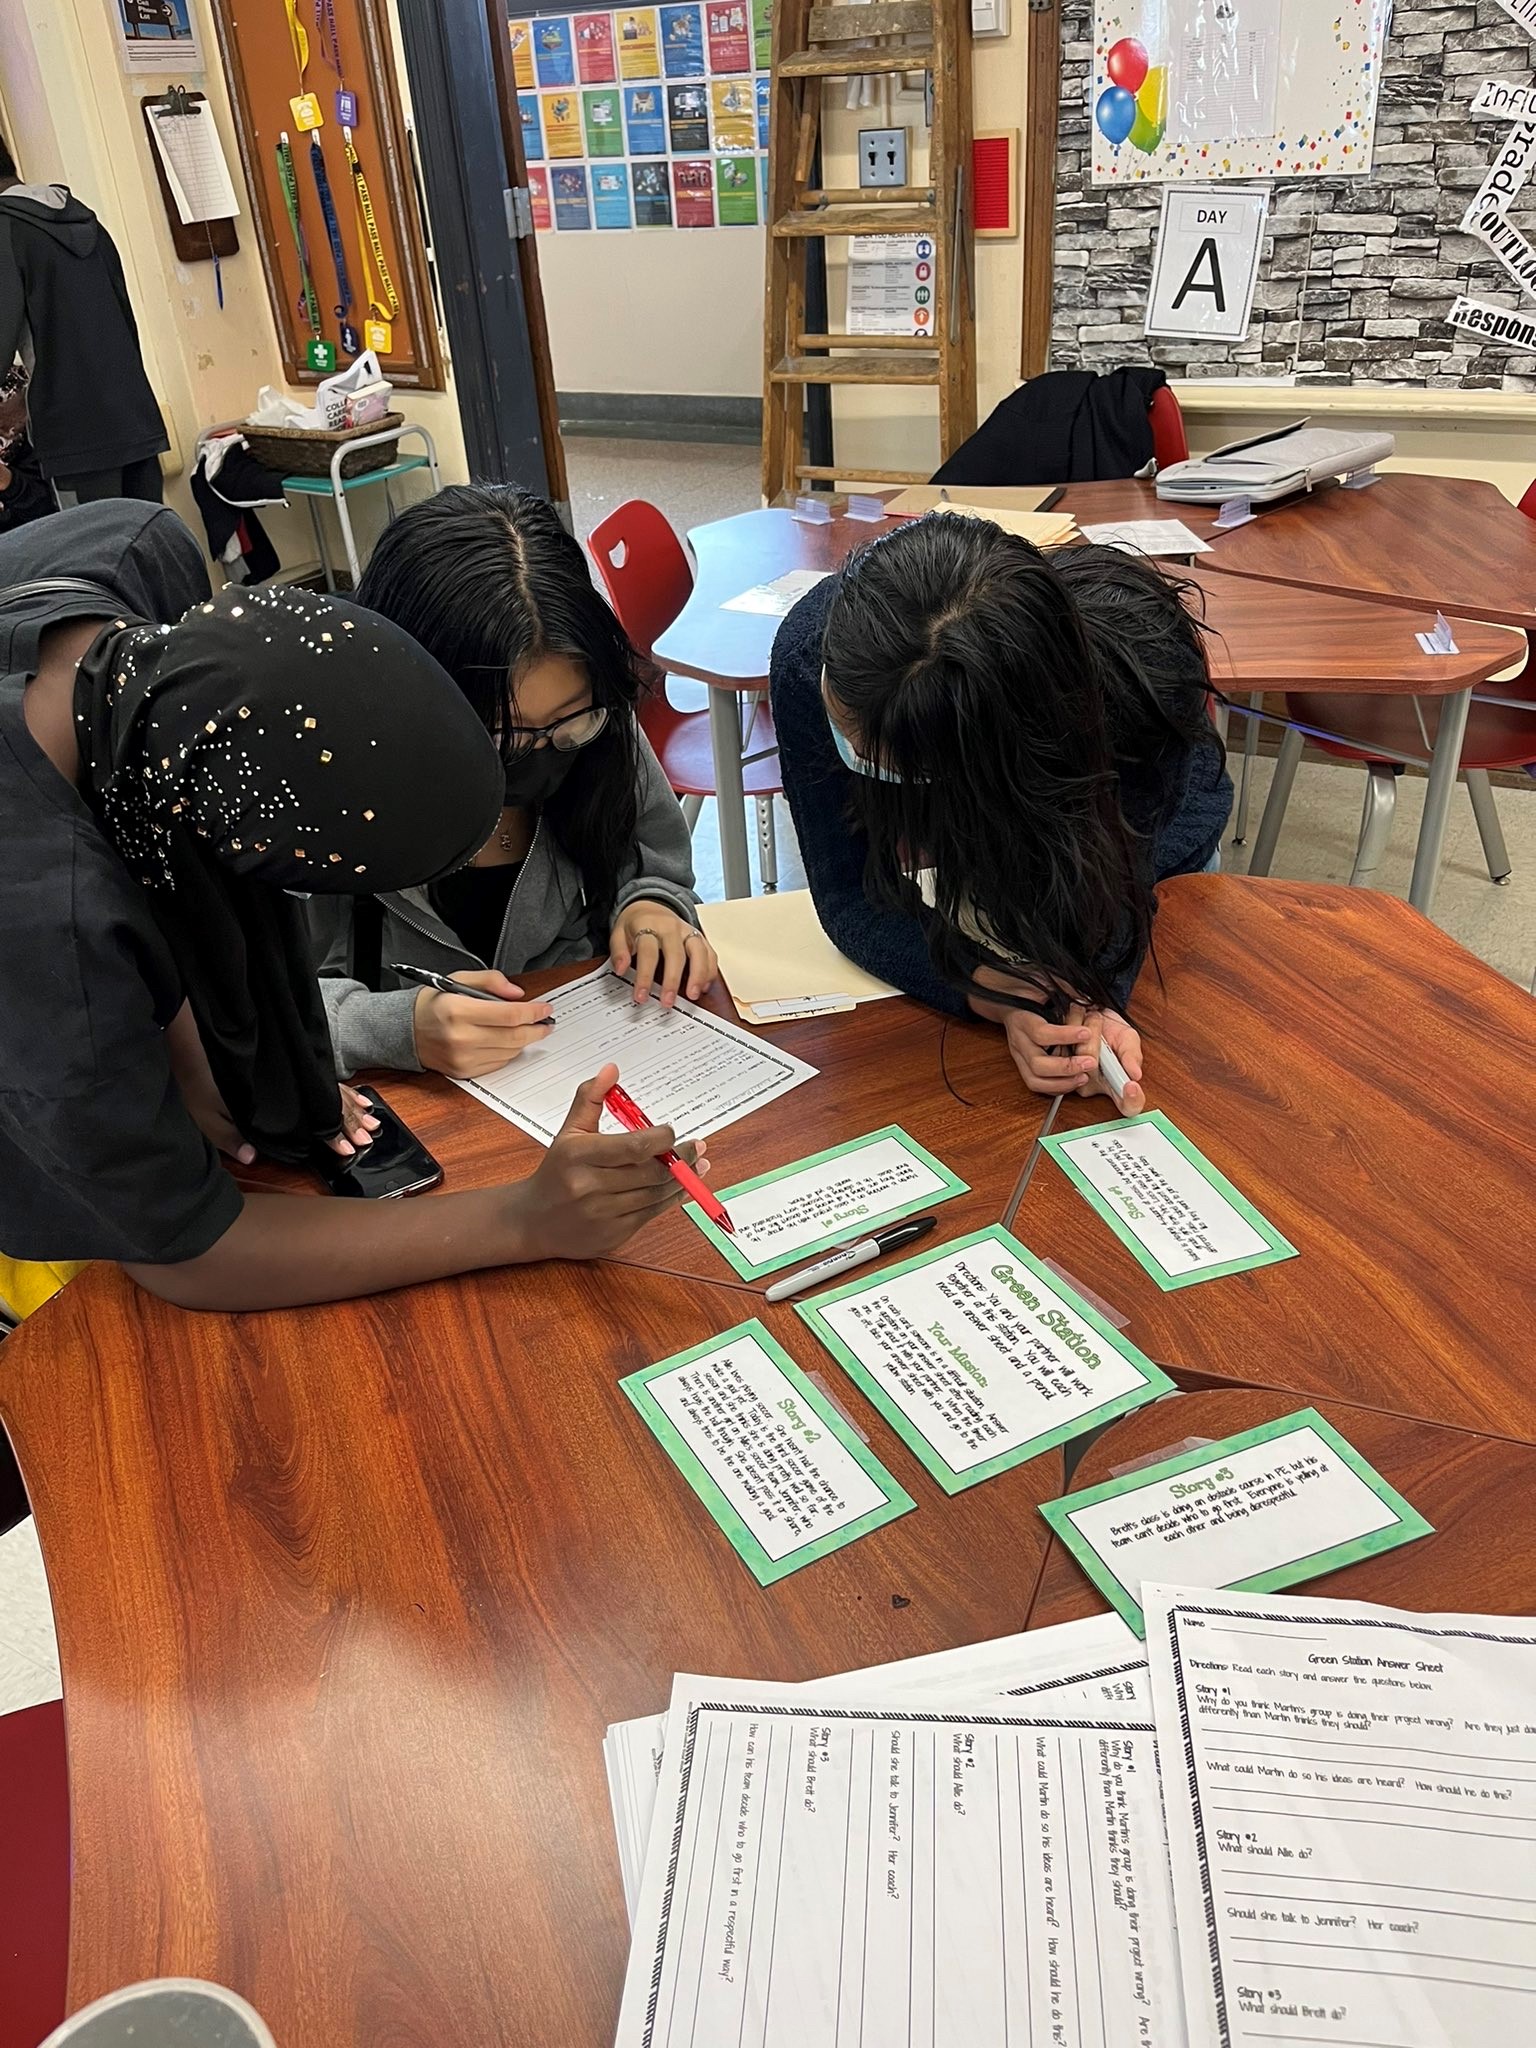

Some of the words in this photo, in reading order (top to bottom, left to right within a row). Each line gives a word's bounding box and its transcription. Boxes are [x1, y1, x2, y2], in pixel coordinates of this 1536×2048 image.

[364, 203, 373, 221] HALL
[1197, 209, 1228, 224] DAY
[368, 222, 378, 240] PASS
[373, 241, 382, 258] HALL
[378, 259, 388, 277] PASS
[1171, 237, 1226, 313] A
[936, 1281, 958, 1298] need
[963, 1310, 990, 1331] answer
[987, 1335, 1013, 1354] sheet
[1008, 1356, 1028, 1370] and
[991, 1265, 1041, 1312] Green
[1035, 1309, 1101, 1370] Station
[927, 1321, 952, 1347] Your
[986, 1292, 1002, 1307] You
[999, 1308, 1018, 1321] and
[1010, 1321, 1033, 1335] your
[1026, 1338, 1061, 1363] partner
[1058, 1365, 1075, 1377] will
[1070, 1377, 1093, 1397] work
[776, 1398, 807, 1430] Story
[1169, 1477, 1216, 1499] Story
[1183, 1618, 1205, 1627] Name
[1308, 1653, 1338, 1664] Green
[1342, 1655, 1373, 1666] Station
[1377, 1657, 1411, 1670] Answer
[1415, 1661, 1443, 1673] Sheet
[1195, 1684, 1217, 1697] Story
[749, 1723, 759, 1738] How
[747, 1741, 755, 1755] can
[745, 1758, 755, 1769] his
[743, 1772, 753, 1790] team
[739, 1793, 751, 1817] decide
[737, 1821, 748, 1837] who
[1216, 1829, 1240, 1844] Story
[736, 1841, 746, 1849] to
[1217, 1842, 1243, 1853] What
[1247, 1844, 1273, 1856] should
[1277, 1847, 1294, 1858] Allie
[1298, 1847, 1313, 1859] do?
[732, 1853, 742, 1863] go
[732, 1867, 744, 1885] first
[730, 1889, 739, 1897] in
[1227, 1907, 1256, 1920] Should
[1260, 1910, 1278, 1921] she
[1281, 1912, 1297, 1923] talk
[1301, 1914, 1310, 1924] to
[1314, 1915, 1357, 1928] Jennifer?
[1367, 1919, 1384, 1930] Her
[1389, 1921, 1419, 1934] coach?
[724, 1910, 736, 1955] respectful
[718, 1959, 734, 1983] way?
[1237, 1986, 1263, 2003] Story
